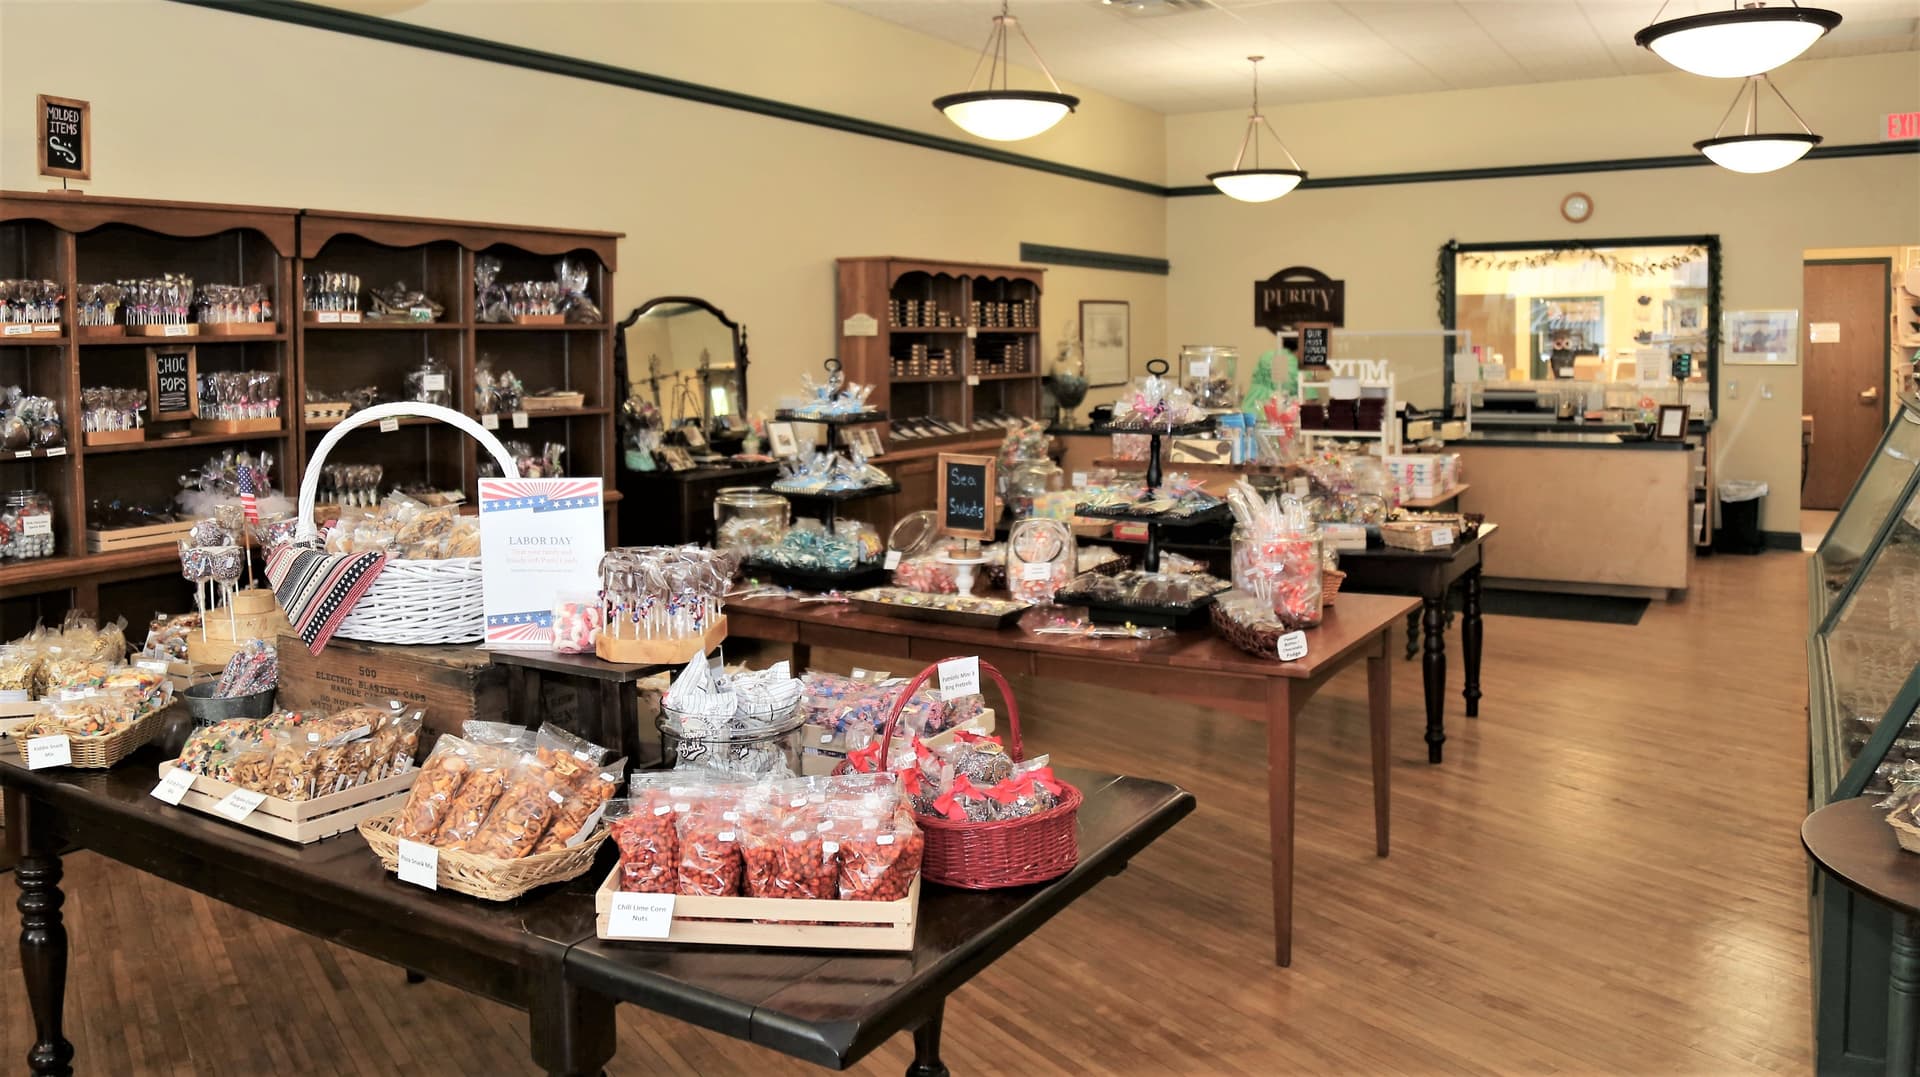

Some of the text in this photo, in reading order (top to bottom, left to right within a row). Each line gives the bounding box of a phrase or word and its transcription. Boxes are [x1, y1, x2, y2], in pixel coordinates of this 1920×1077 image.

[47, 106, 79, 123] MOLDED
[49, 121, 77, 135] ITEMS
[1263, 288, 1334, 312] PURITY
[157, 357, 186, 374] CHOC
[1326, 359, 1389, 386] YUM
[160, 377, 186, 392] POPS
[951, 467, 977, 486] Sea
[949, 497, 985, 519] Sweets
[509, 536, 572, 545] LABOR DAY
[358, 666, 377, 678] 500
[315, 671, 353, 686] ELECTRIC
[358, 680, 399, 697] BLASTING
[403, 690, 426, 702] CAPS
[330, 684, 362, 698] HANDLE
